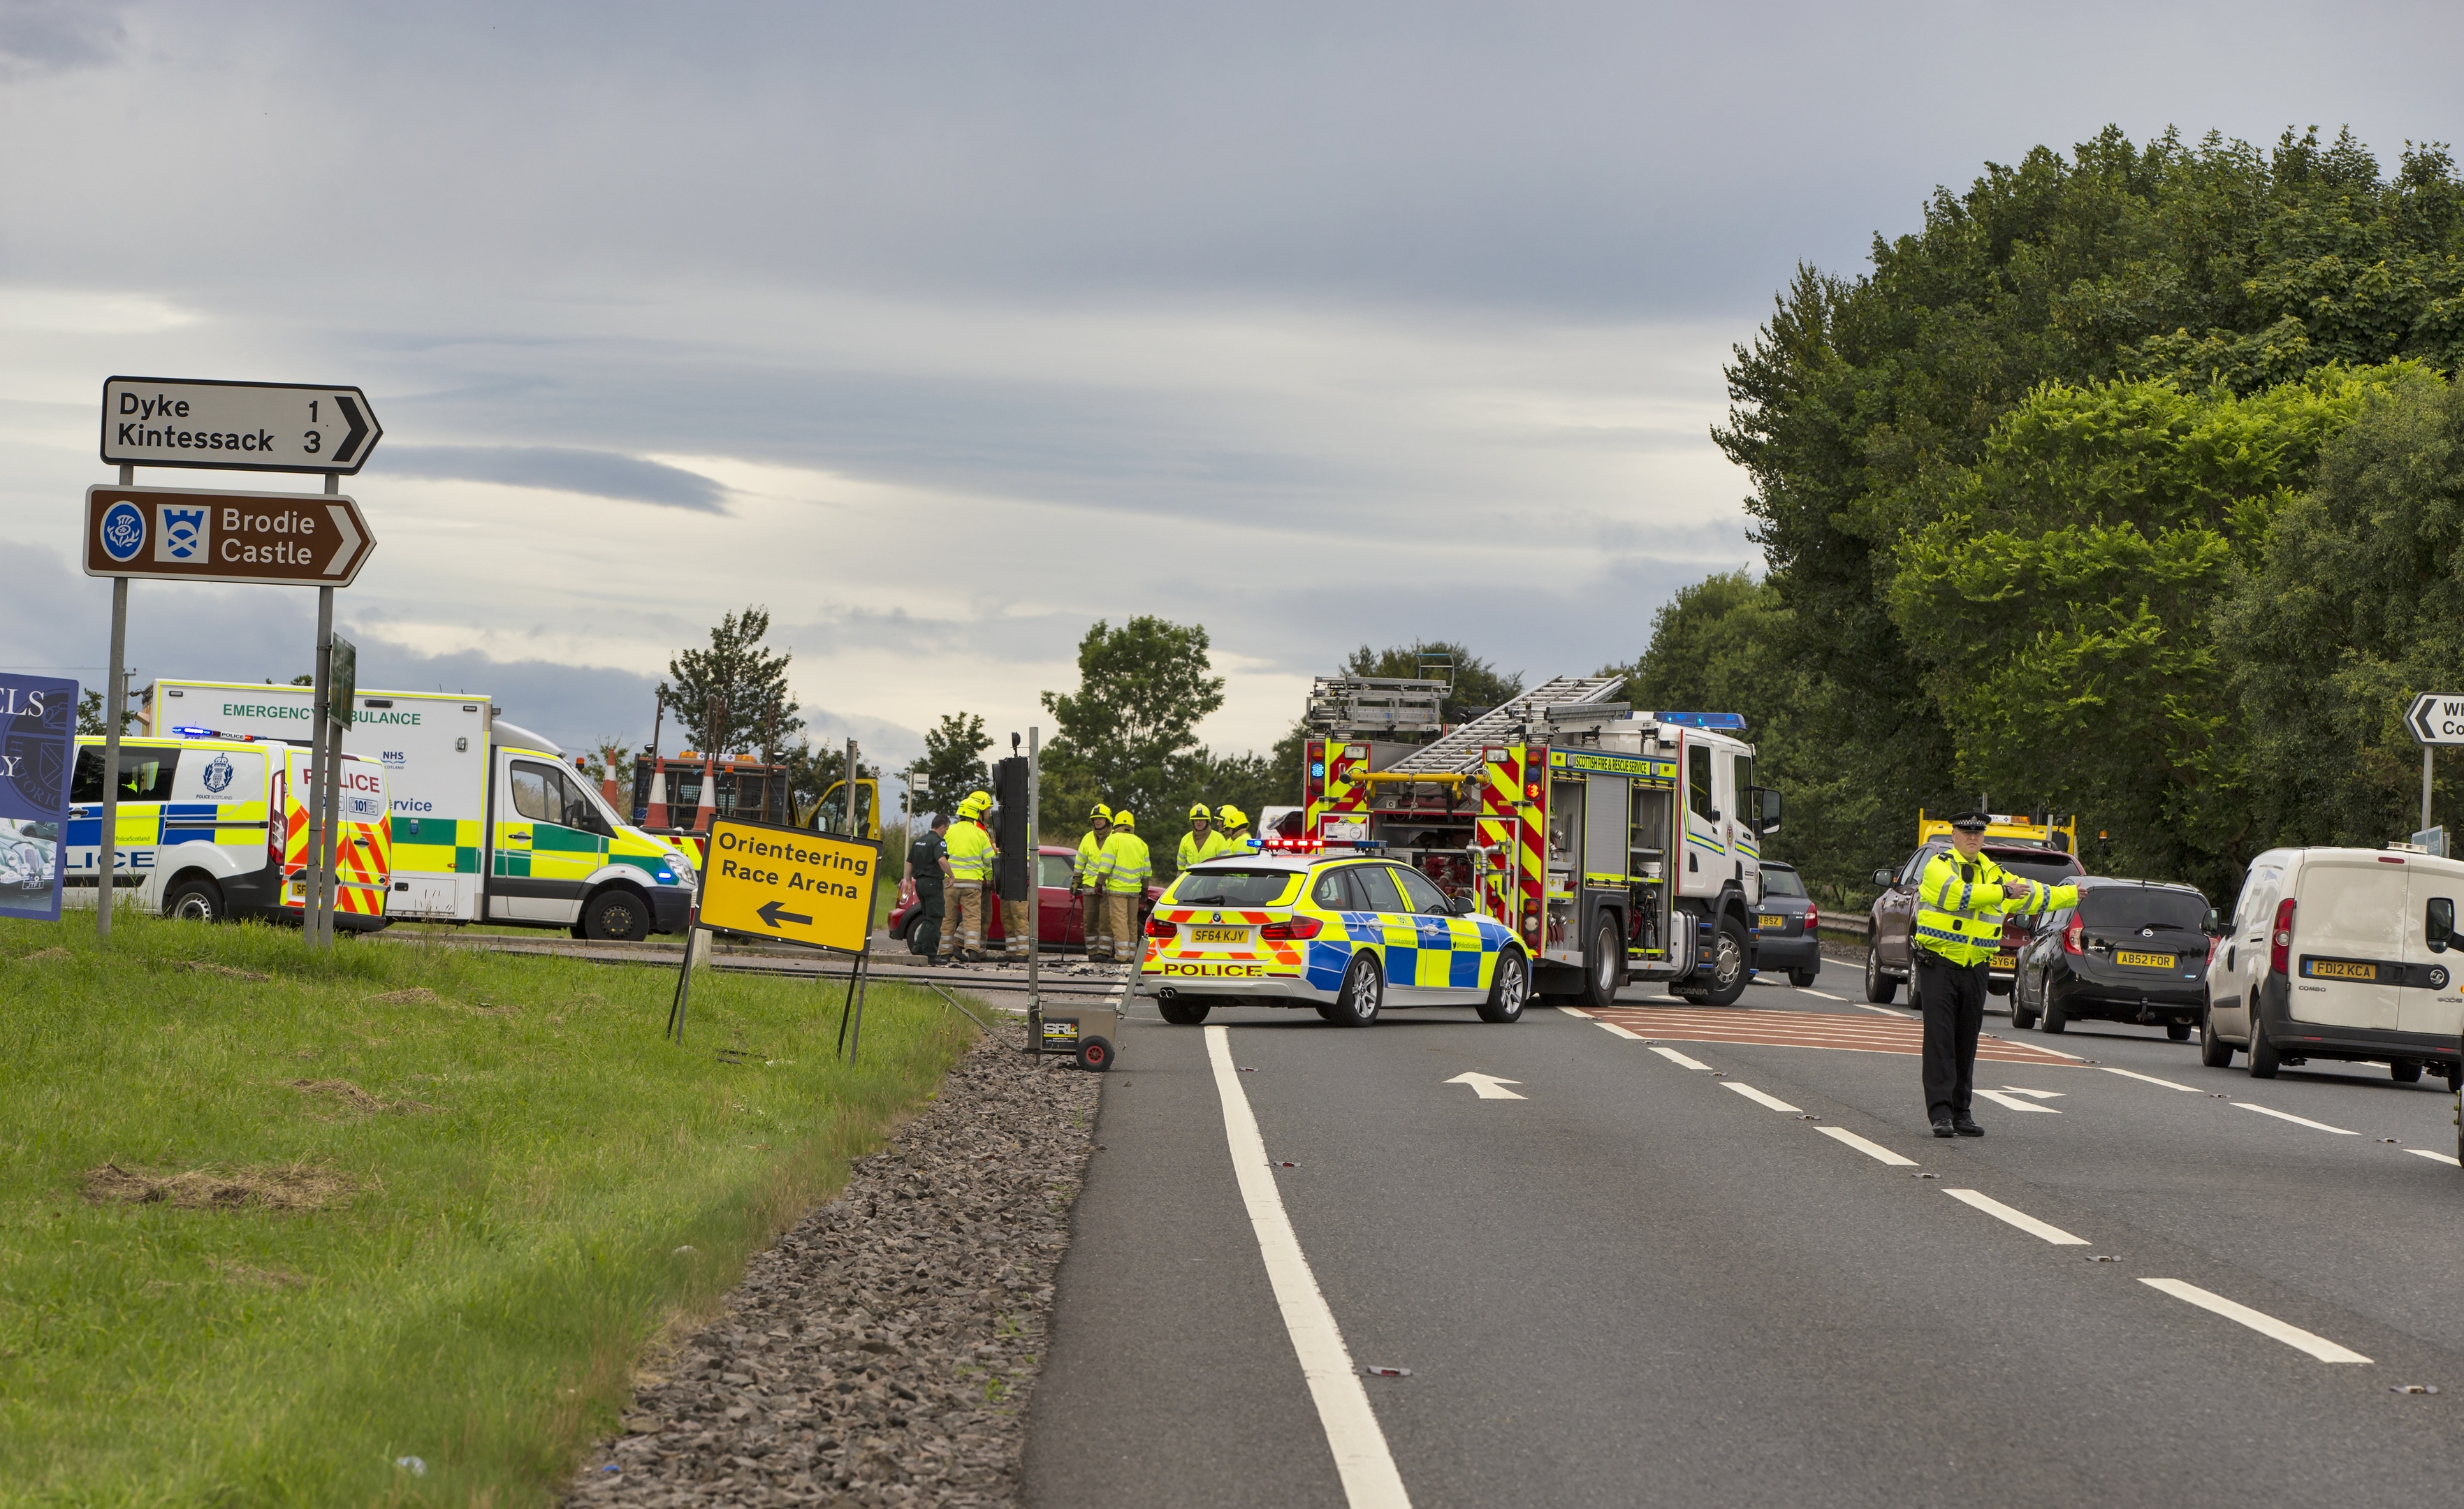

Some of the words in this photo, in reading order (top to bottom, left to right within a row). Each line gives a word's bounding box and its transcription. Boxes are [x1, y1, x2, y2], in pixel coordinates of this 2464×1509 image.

[119, 392, 190, 421] Dyke
[308, 400, 319, 423] 1
[118, 423, 275, 452] Kintessack
[303, 430, 321, 453] 3
[222, 508, 315, 534] Brodie
[221, 538, 312, 564] Castle
[383, 751, 404, 760] NHS
[1576, 755, 1597, 768] SCOTTISH
[1598, 758, 1608, 770] FIRE
[1608, 759, 1611, 771] &
[1612, 759, 1628, 773] RESCUE
[1629, 761, 1647, 774] SERVICE
[354, 800, 367, 812] 101
[719, 832, 868, 876] Orienteering
[722, 859, 779, 885] Race
[787, 872, 858, 900] Arena
[1195, 930, 1221, 941] SF64
[1224, 931, 1244, 942] KJY
[1992, 957, 2015, 966] SY64
[2122, 954, 2148, 965] AB52
[2150, 956, 2170, 966] FOR
[1165, 963, 1263, 977] POLICE
[2317, 963, 2344, 975] FD12
[2347, 965, 2370, 977] KCA
[1672, 986, 1709, 996] SCANIA
[1043, 1023, 1077, 1035] SRL
